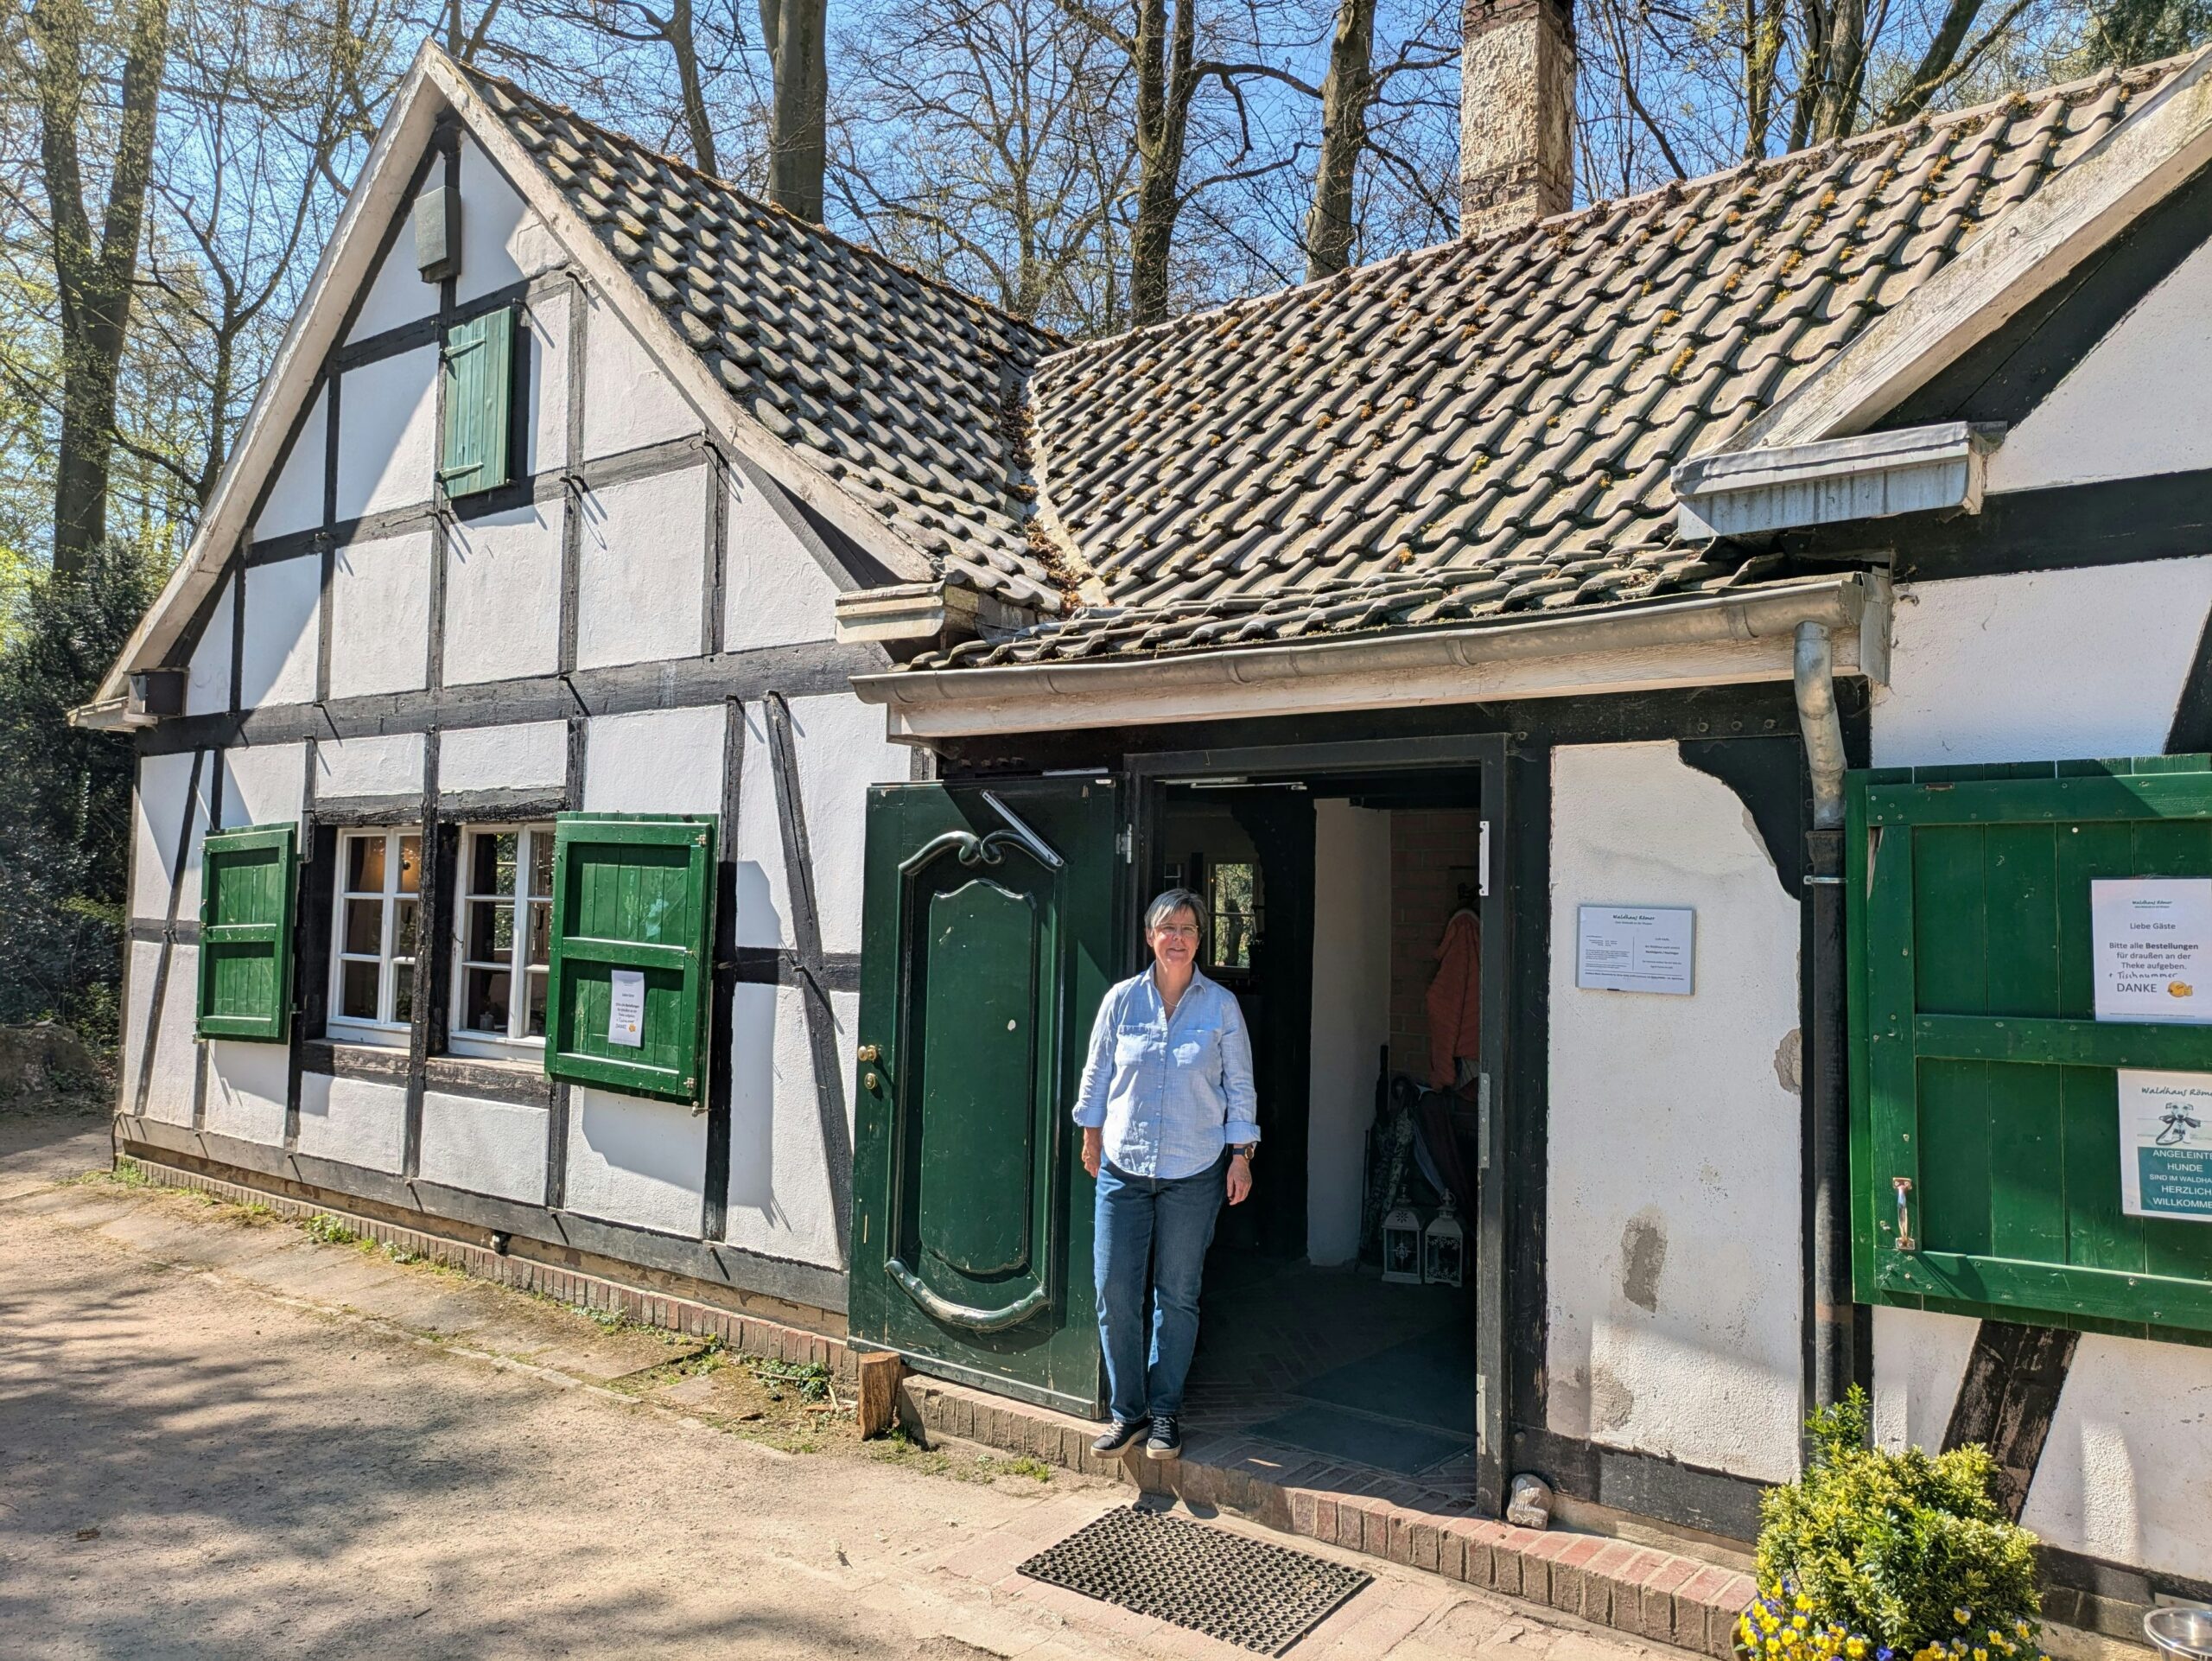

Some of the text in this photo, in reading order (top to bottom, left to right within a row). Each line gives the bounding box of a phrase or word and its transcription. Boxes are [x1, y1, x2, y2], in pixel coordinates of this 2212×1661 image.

[2145, 942, 2199, 951] Bestellungen
[2146, 962, 2187, 971] aufgeben.
[2117, 971, 2178, 980] Tischnummer
[2116, 983, 2158, 993] DANKE
[2141, 1086, 2187, 1097] Waldhaus
[2167, 1162, 2203, 1173] HUNDE
[2161, 1185, 2212, 1196] HERZLICH
